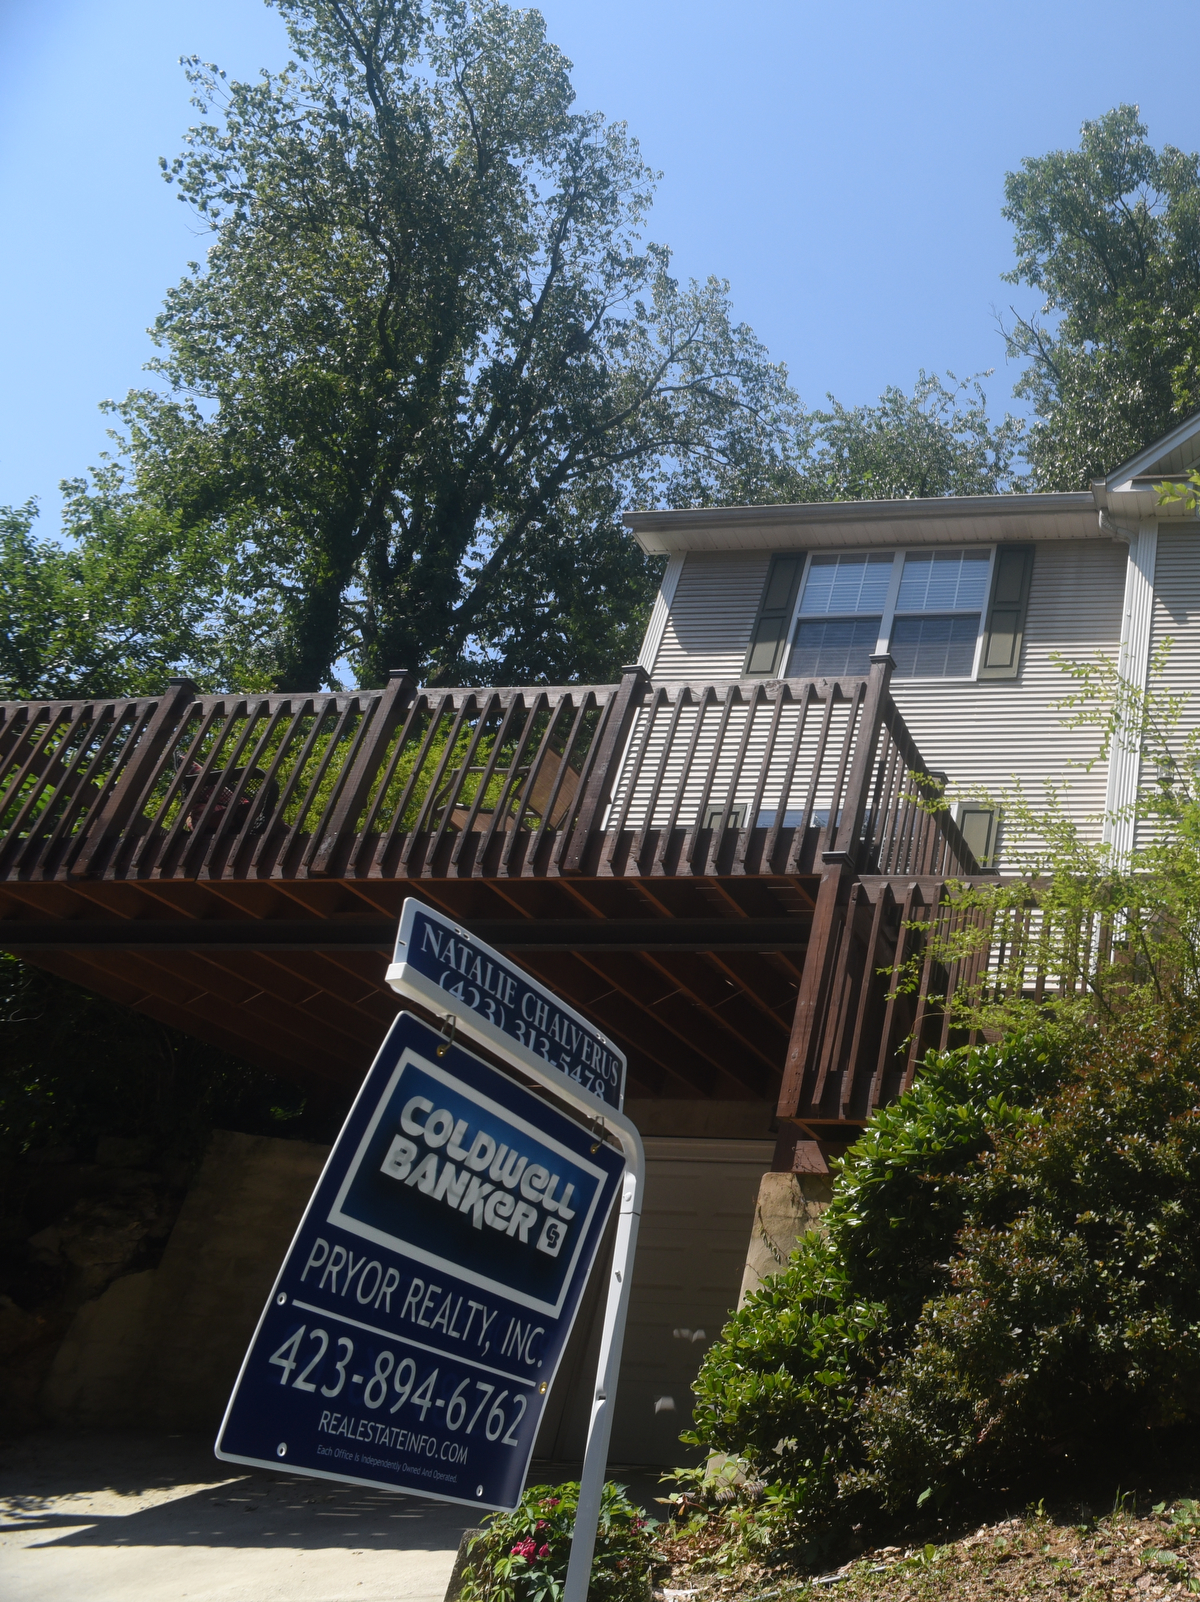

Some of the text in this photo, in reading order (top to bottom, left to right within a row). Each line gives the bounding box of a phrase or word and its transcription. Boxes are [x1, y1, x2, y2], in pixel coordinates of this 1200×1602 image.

[421, 922, 619, 1087] NATALIE CHALVERUS
[300, 1237, 545, 1368] PRYOR REALTY, INC.
[268, 1324, 528, 1447] 423-894-6762
[318, 1410, 468, 1465] REALESTATEINFO.COM
[316, 1445, 333, 1456] Each
[334, 1448, 353, 1460] Office
[354, 1453, 360, 1462] Is
[361, 1454, 401, 1472] Independently
[402, 1463, 421, 1475] Owned
[421, 1468, 432, 1478] And
